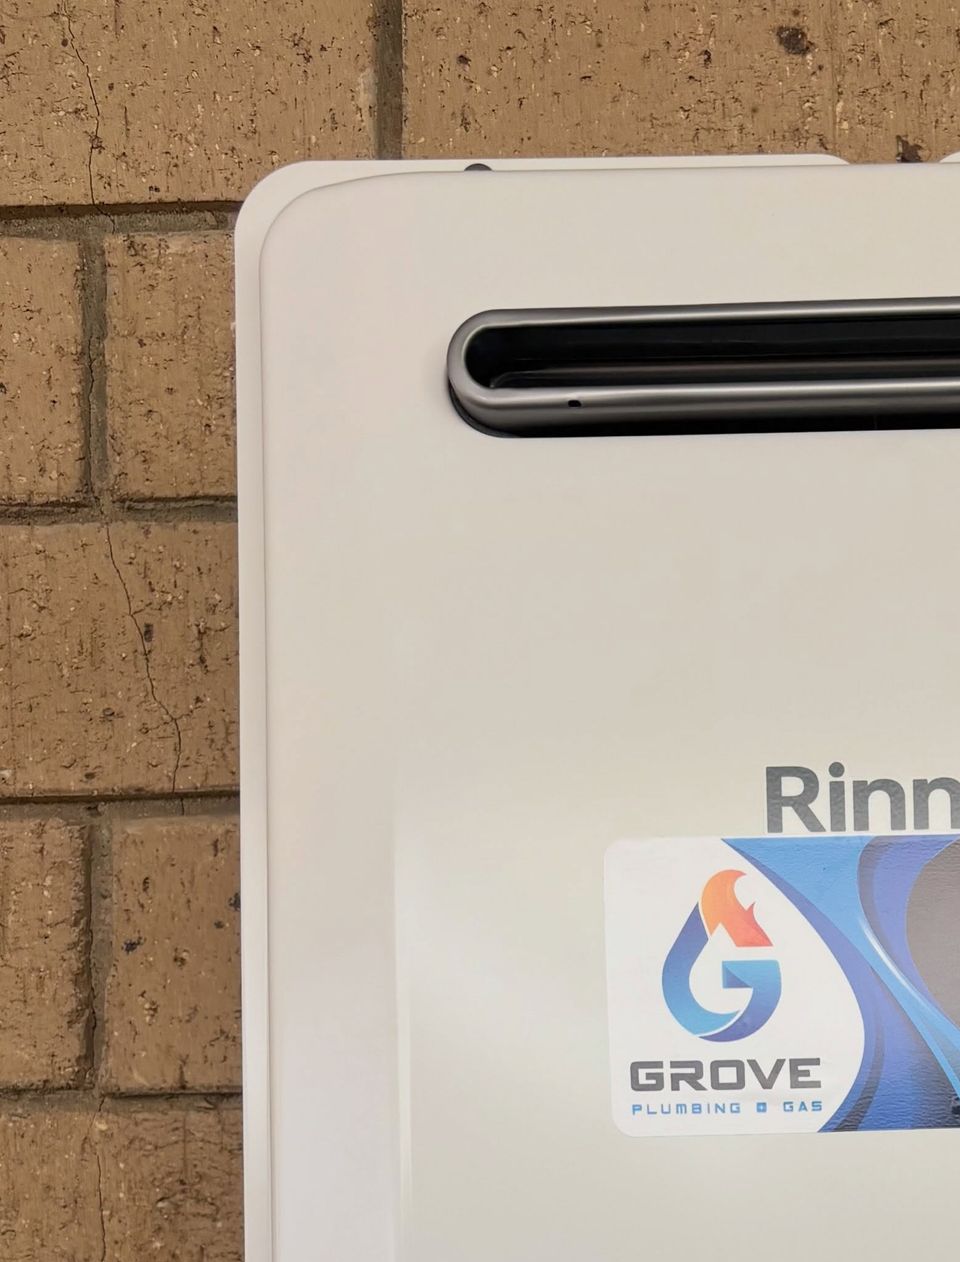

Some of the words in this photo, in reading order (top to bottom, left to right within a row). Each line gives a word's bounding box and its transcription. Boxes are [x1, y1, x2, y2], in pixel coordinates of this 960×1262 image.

[630, 1057, 822, 1092] GROVE
[632, 1103, 741, 1116] PLUMBING
[783, 1101, 823, 1112] GAS
